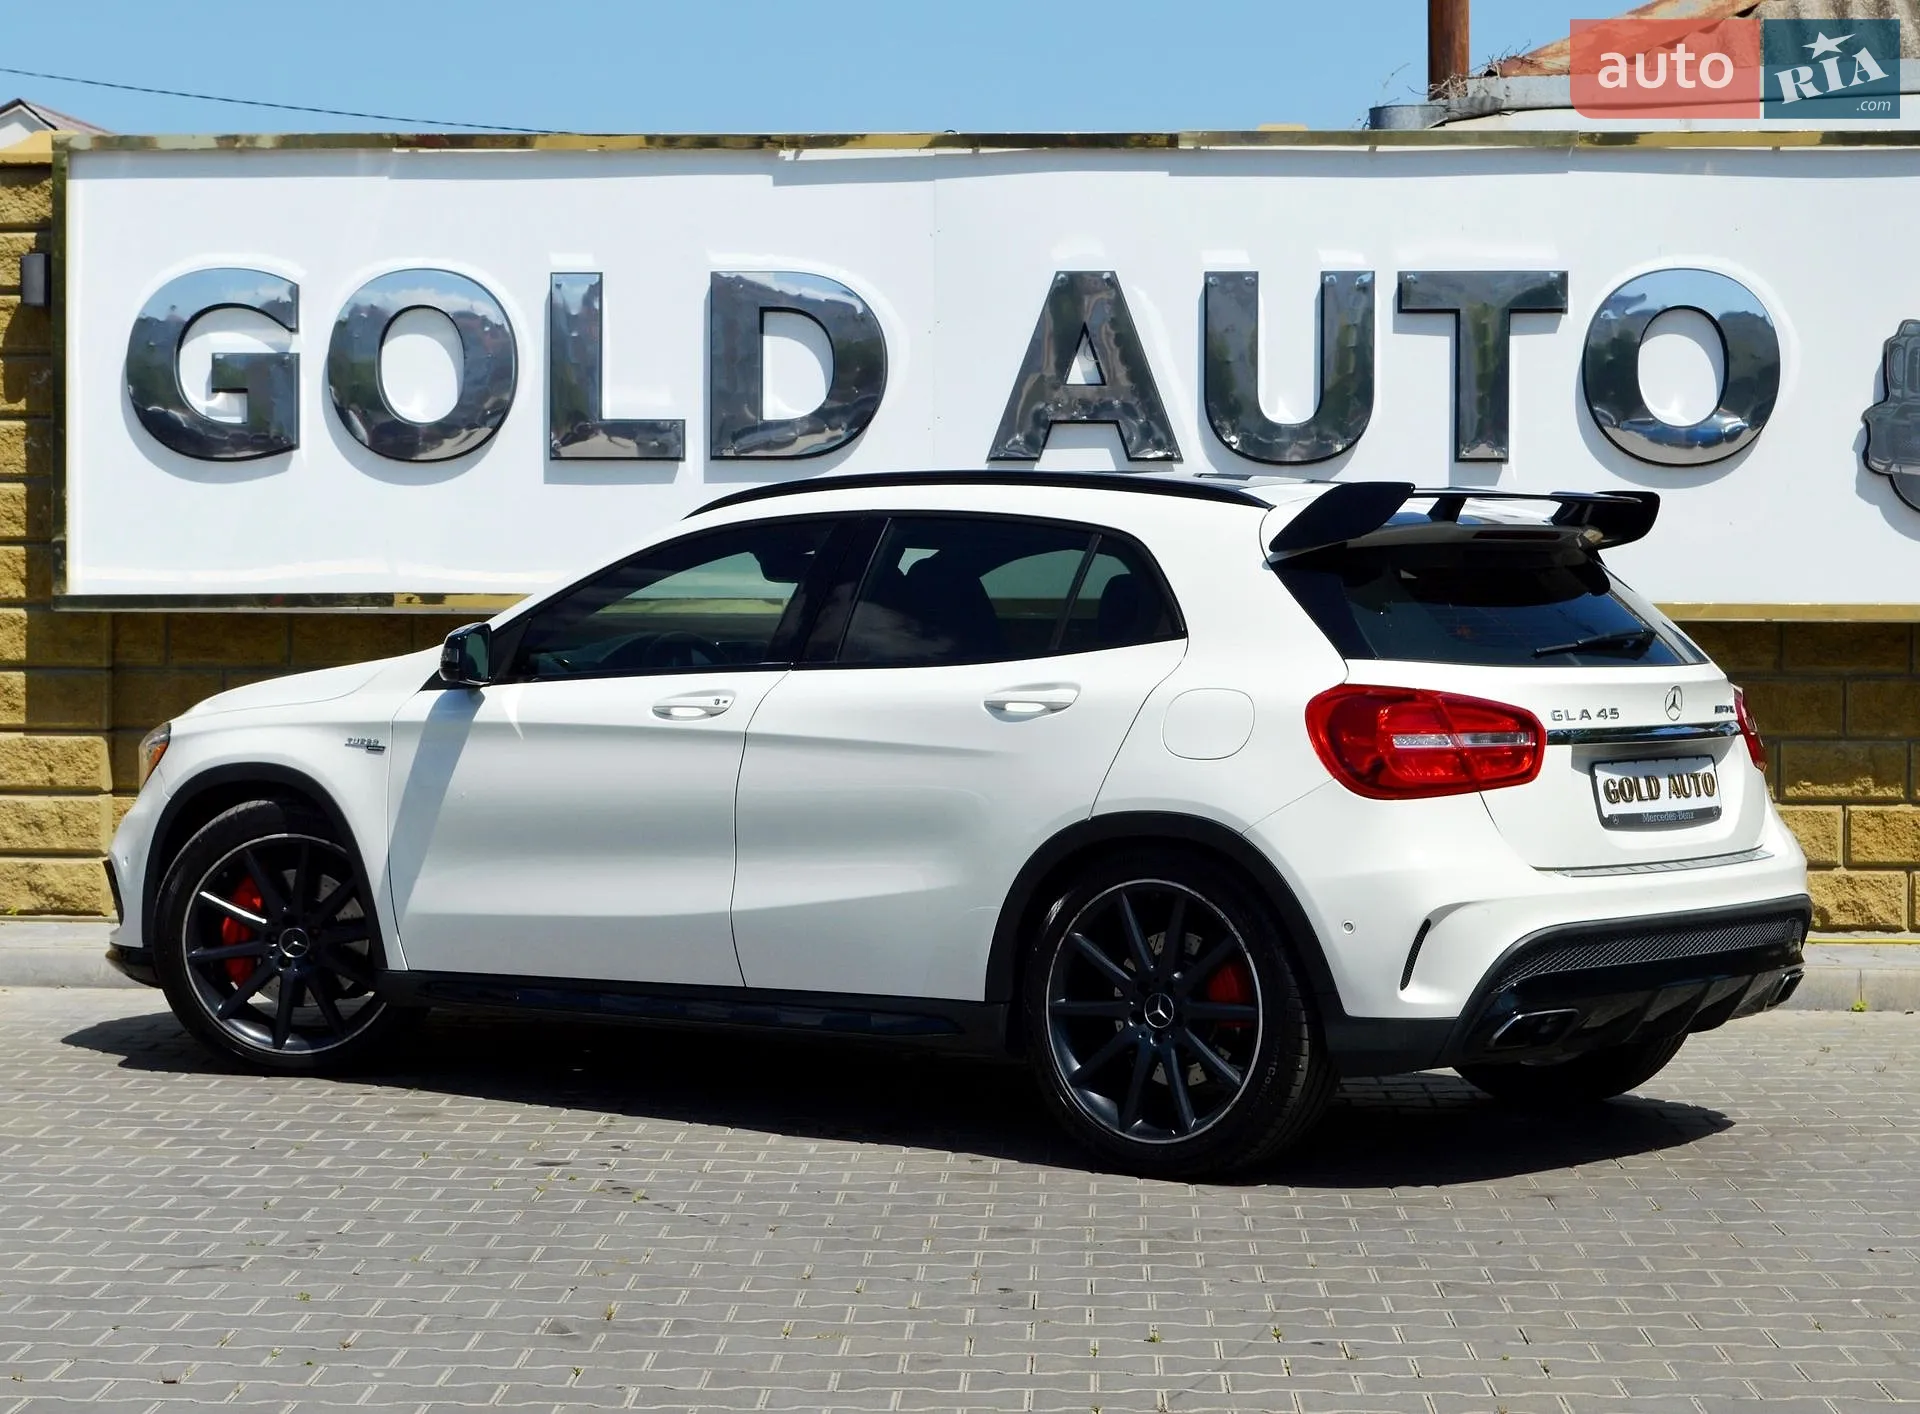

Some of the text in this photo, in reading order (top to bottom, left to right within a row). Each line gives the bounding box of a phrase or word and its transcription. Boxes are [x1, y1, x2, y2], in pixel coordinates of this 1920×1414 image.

[125, 267, 1781, 467] GOLD AUTO
[1550, 707, 1619, 721] GLA 45
[1603, 772, 1716, 804] GOLD AUTO
[1642, 811, 1695, 822] Mercedes-Benz
